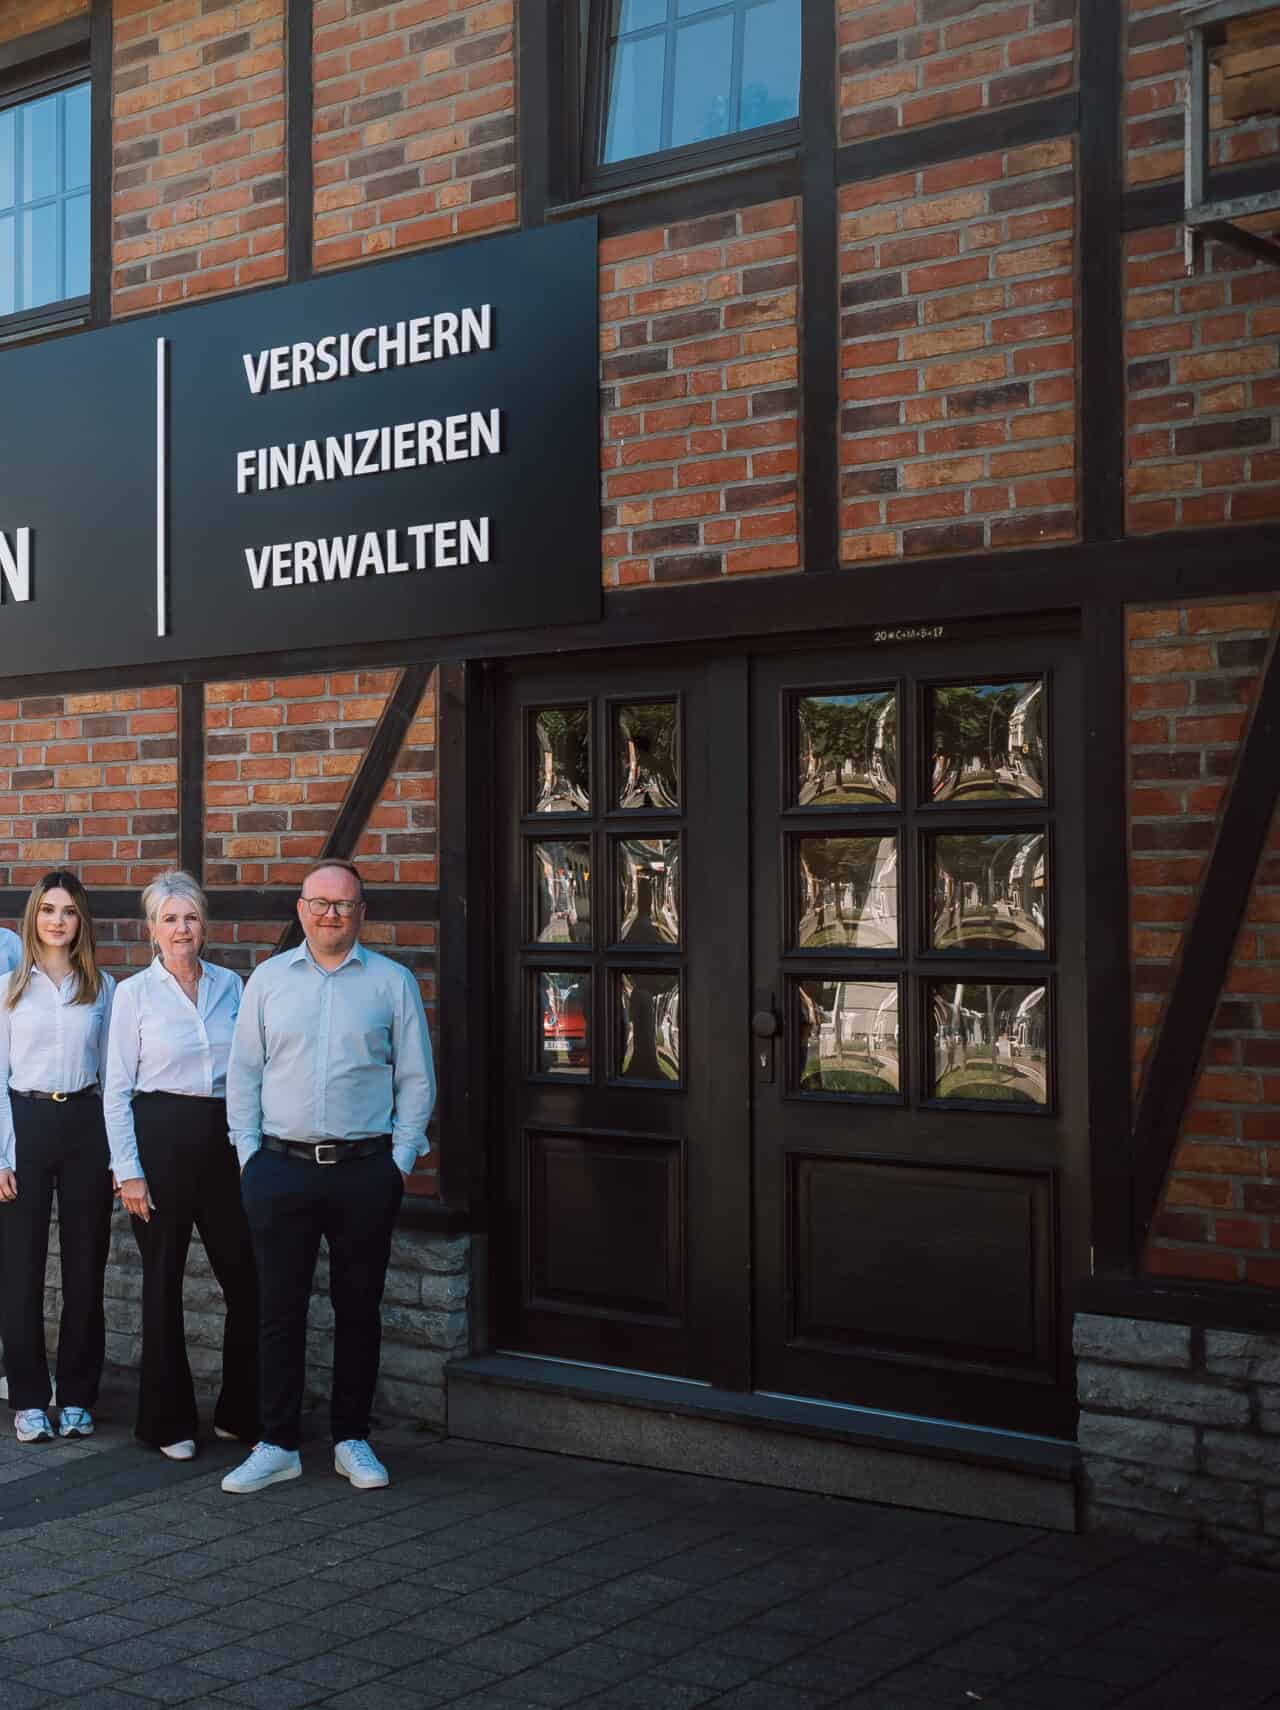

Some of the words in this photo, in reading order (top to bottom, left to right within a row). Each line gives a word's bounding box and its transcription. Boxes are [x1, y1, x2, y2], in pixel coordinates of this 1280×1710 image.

[243, 304, 490, 394] VERSICHERN
[237, 408, 500, 493] FINANZIEREN
[245, 517, 489, 589] VERWALTEN
